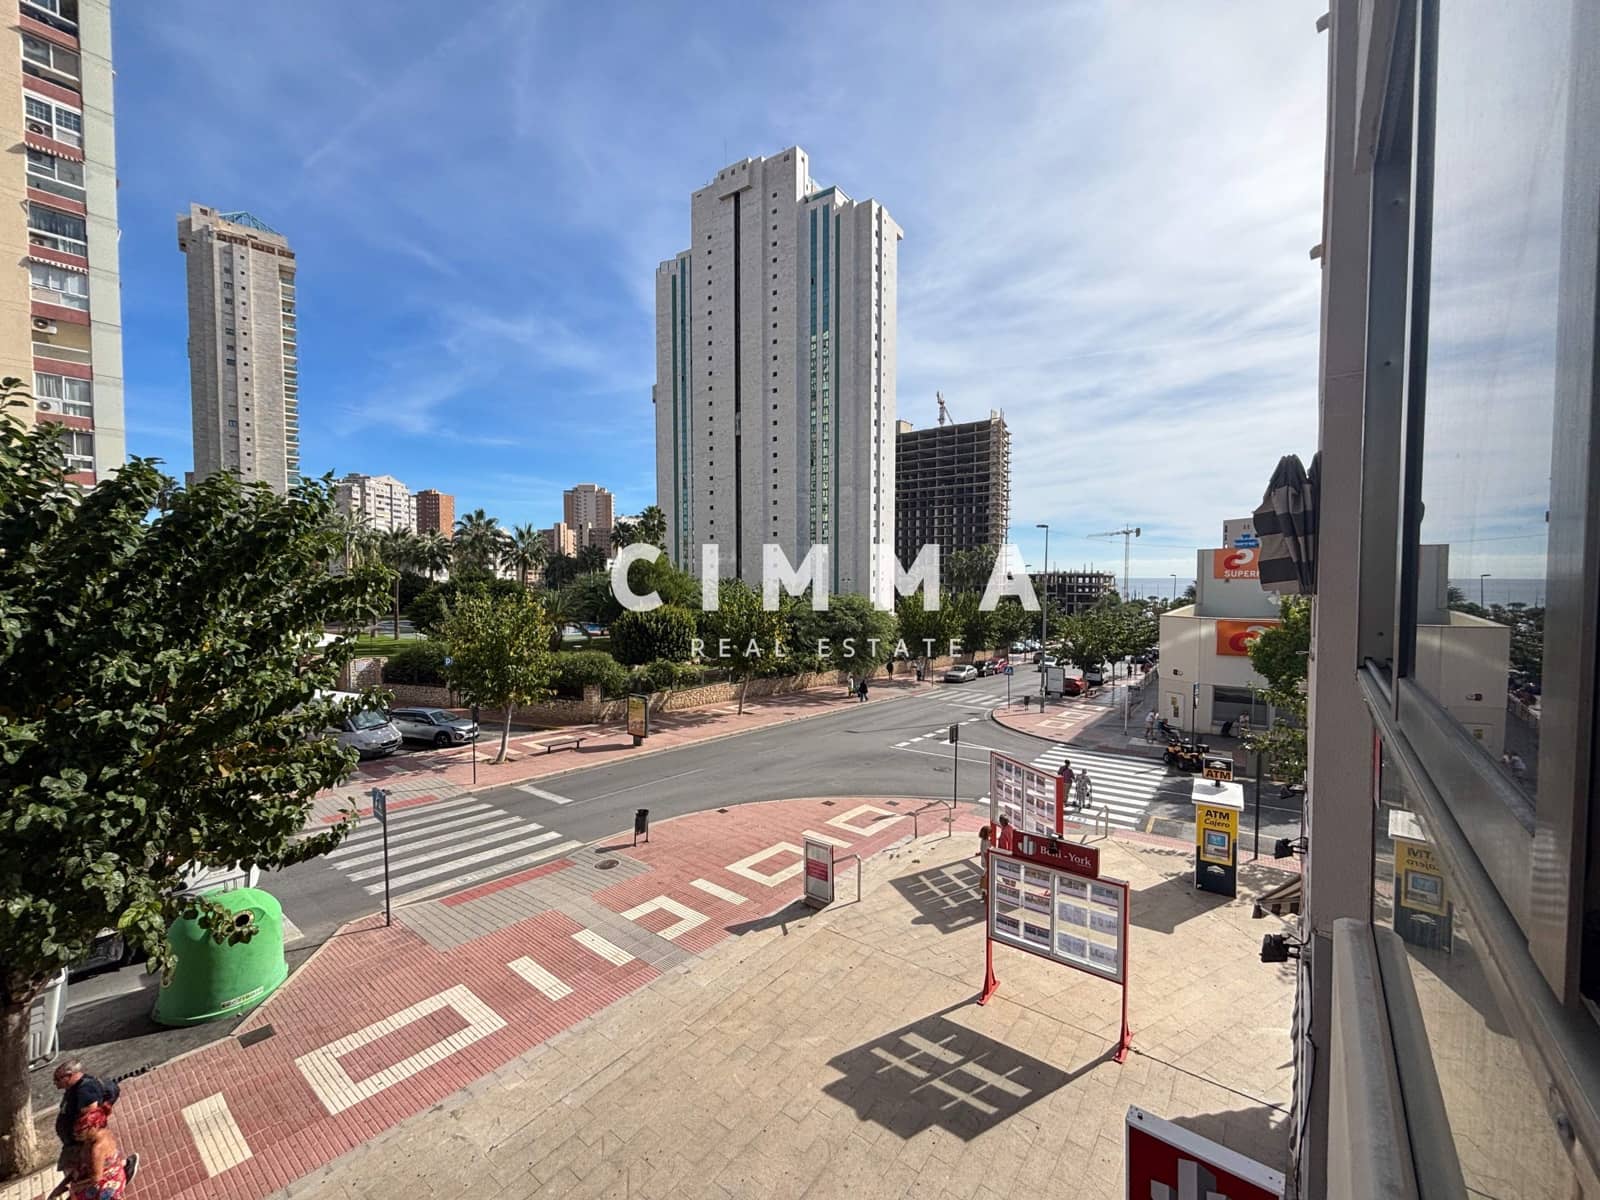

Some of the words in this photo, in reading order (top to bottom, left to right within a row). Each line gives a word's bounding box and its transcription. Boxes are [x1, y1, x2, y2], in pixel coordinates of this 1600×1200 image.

[1206, 768, 1231, 780] ATM
[1205, 809, 1230, 820] ATM
[1204, 818, 1230, 829] Cajero
